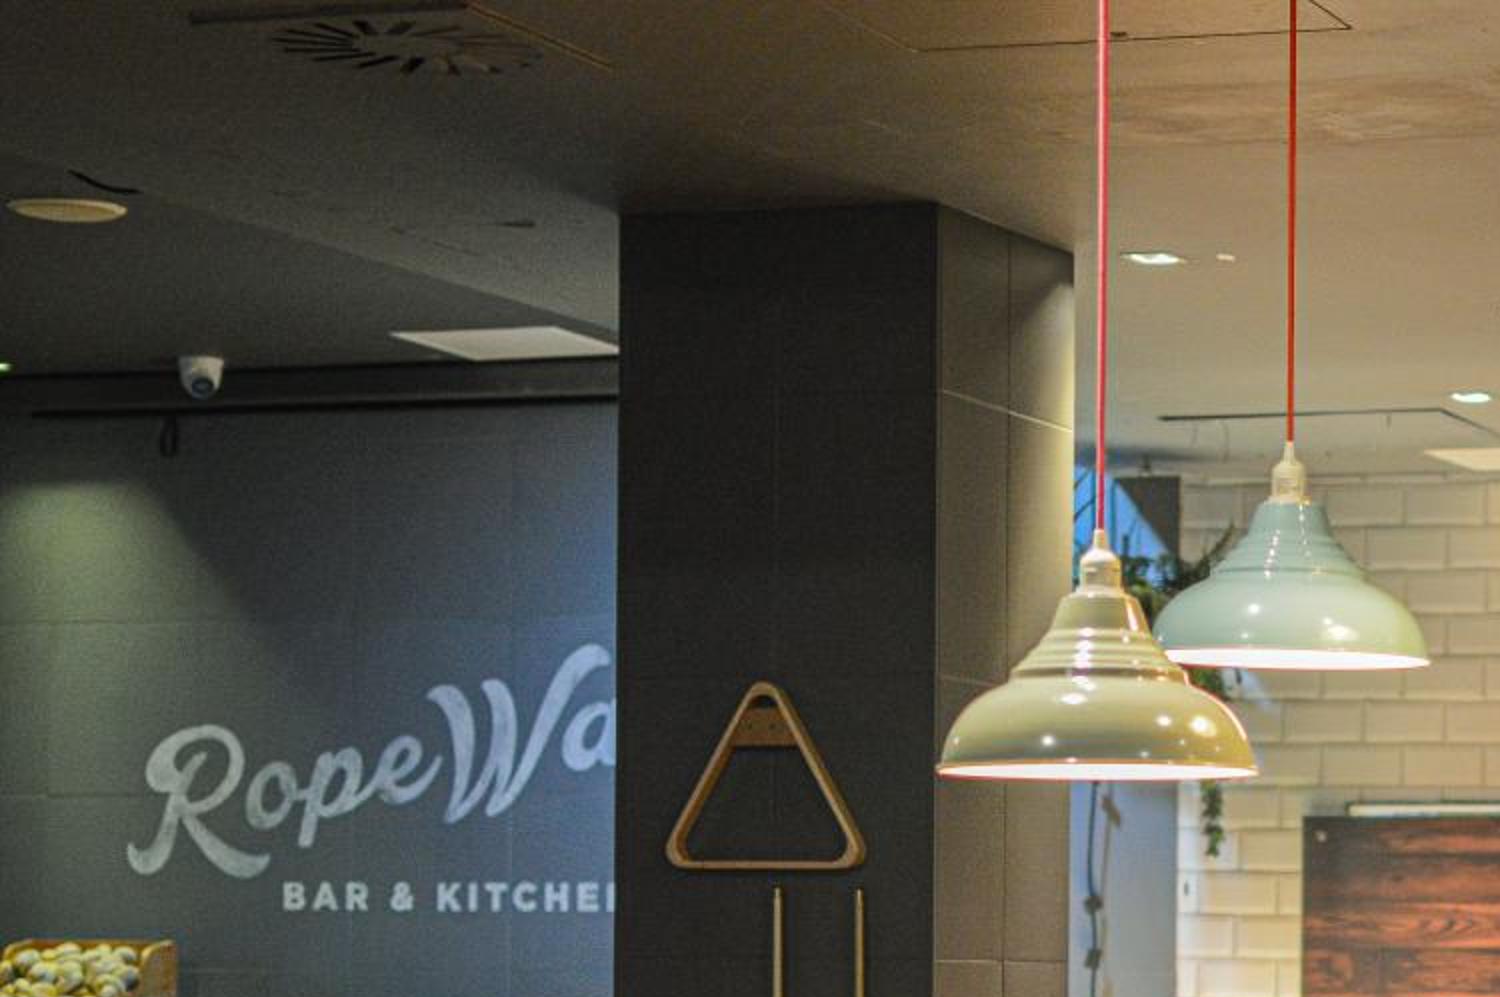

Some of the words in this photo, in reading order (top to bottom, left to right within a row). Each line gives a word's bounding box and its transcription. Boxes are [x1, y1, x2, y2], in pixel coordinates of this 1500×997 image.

[127, 643, 617, 879] RopeWa
[282, 881, 369, 912] BAR
[390, 882, 415, 912] &
